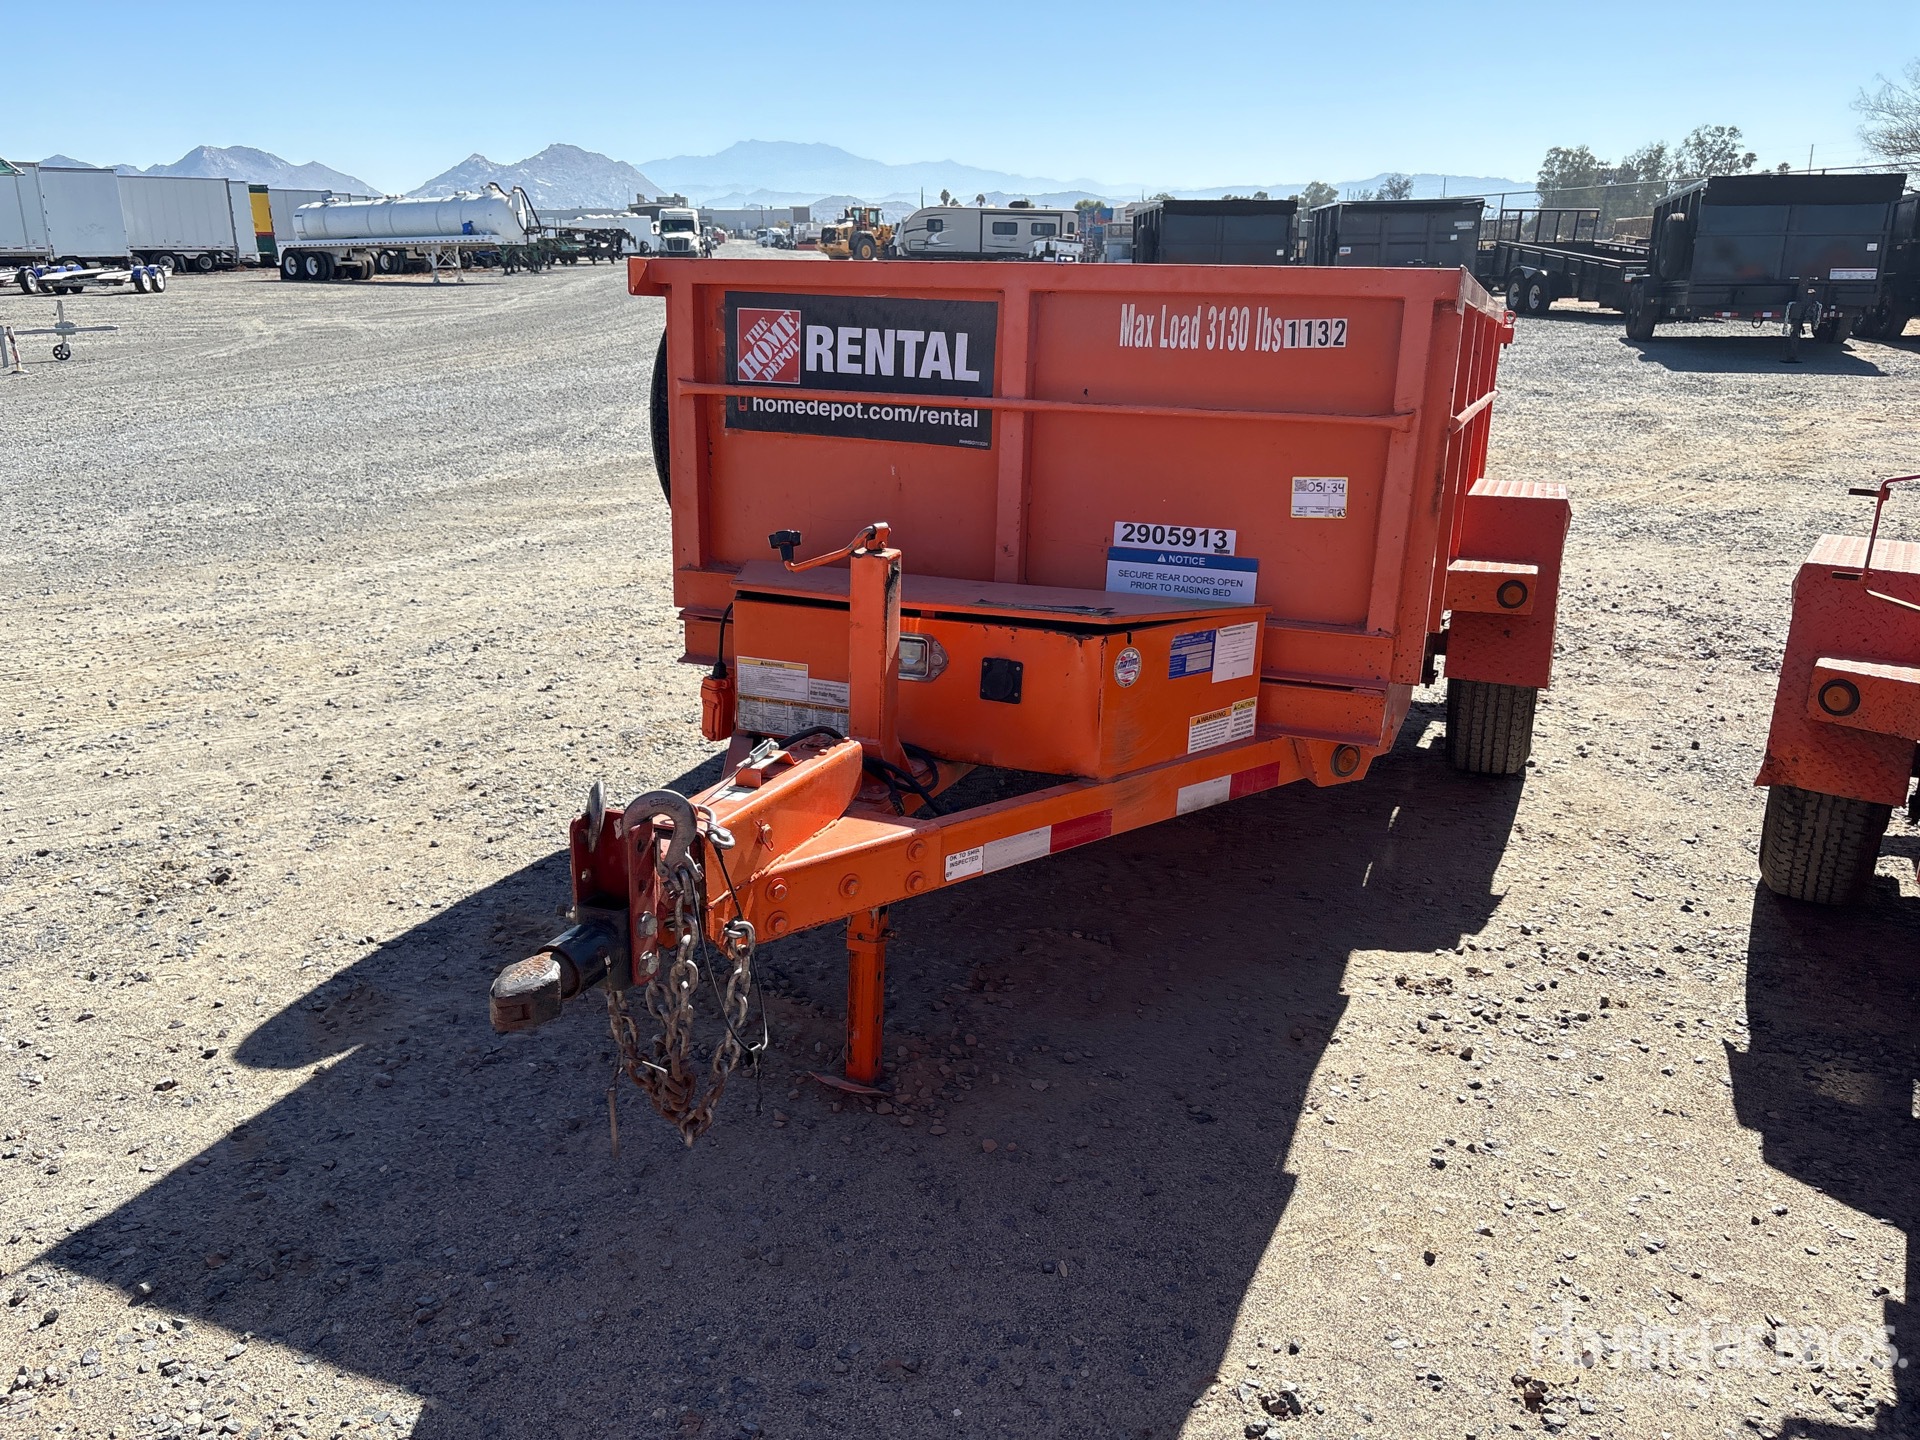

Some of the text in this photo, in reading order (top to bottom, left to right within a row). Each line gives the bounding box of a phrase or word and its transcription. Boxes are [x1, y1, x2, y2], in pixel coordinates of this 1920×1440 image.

[744, 317, 771, 346] THE
[1119, 303, 1347, 352] Max Load 3130 lbs 1132
[738, 310, 800, 380] HOME
[806, 325, 979, 382] RENTAL
[762, 338, 800, 381] DEPOT
[753, 397, 978, 428] homedepot.com/rental
[1121, 522, 1228, 550] 2905913
[1168, 555, 1206, 566] NOTICE
[1118, 569, 1243, 588] SECURE REAR DOORS OPEN
[1130, 580, 1231, 597] PRIOR TO RAISING BED
[1200, 710, 1226, 723] WARNING
[949, 854, 958, 862] OK
[949, 855, 979, 868] INSPECTED
